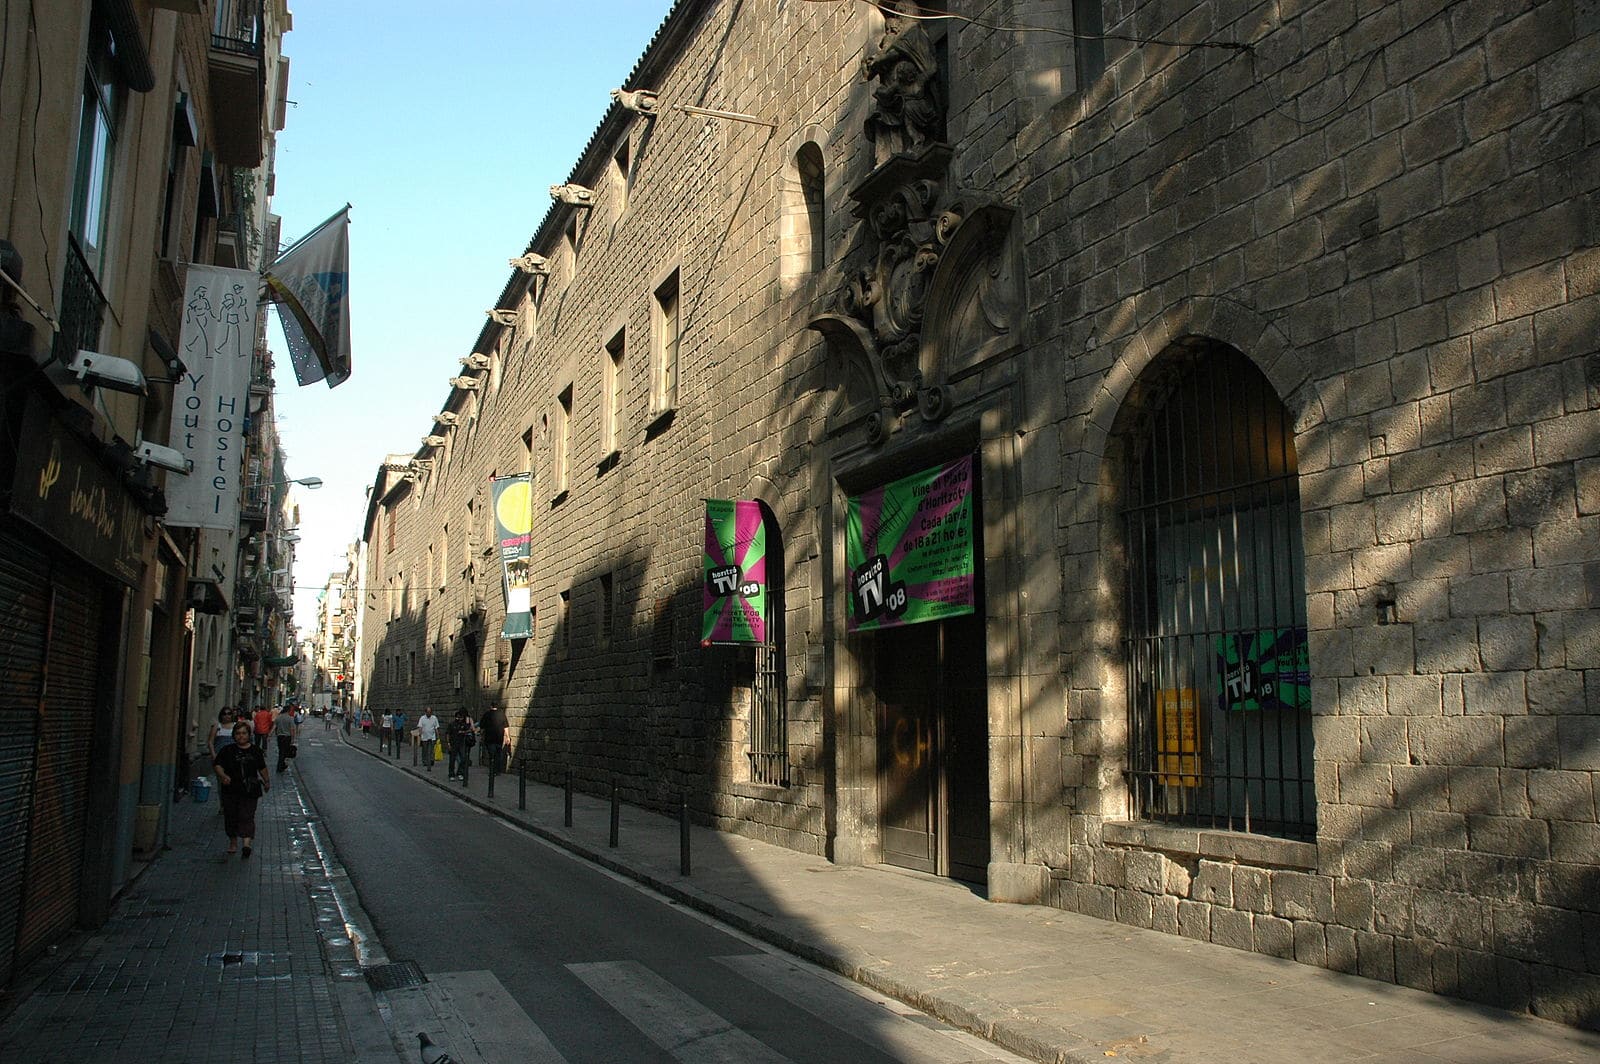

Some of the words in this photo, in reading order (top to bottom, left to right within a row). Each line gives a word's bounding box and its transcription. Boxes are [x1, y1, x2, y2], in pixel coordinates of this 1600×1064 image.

[212, 395, 236, 514] Hostel
[912, 483, 930, 498] Vine
[932, 478, 941, 493] al
[920, 515, 942, 531] Cada
[903, 540, 913, 553] de
[914, 535, 924, 550] 18
[931, 529, 942, 545] 21
[713, 573, 738, 594] TV
[739, 583, 759, 595] '08
[858, 571, 883, 615] TV
[885, 588, 906, 611] '08
